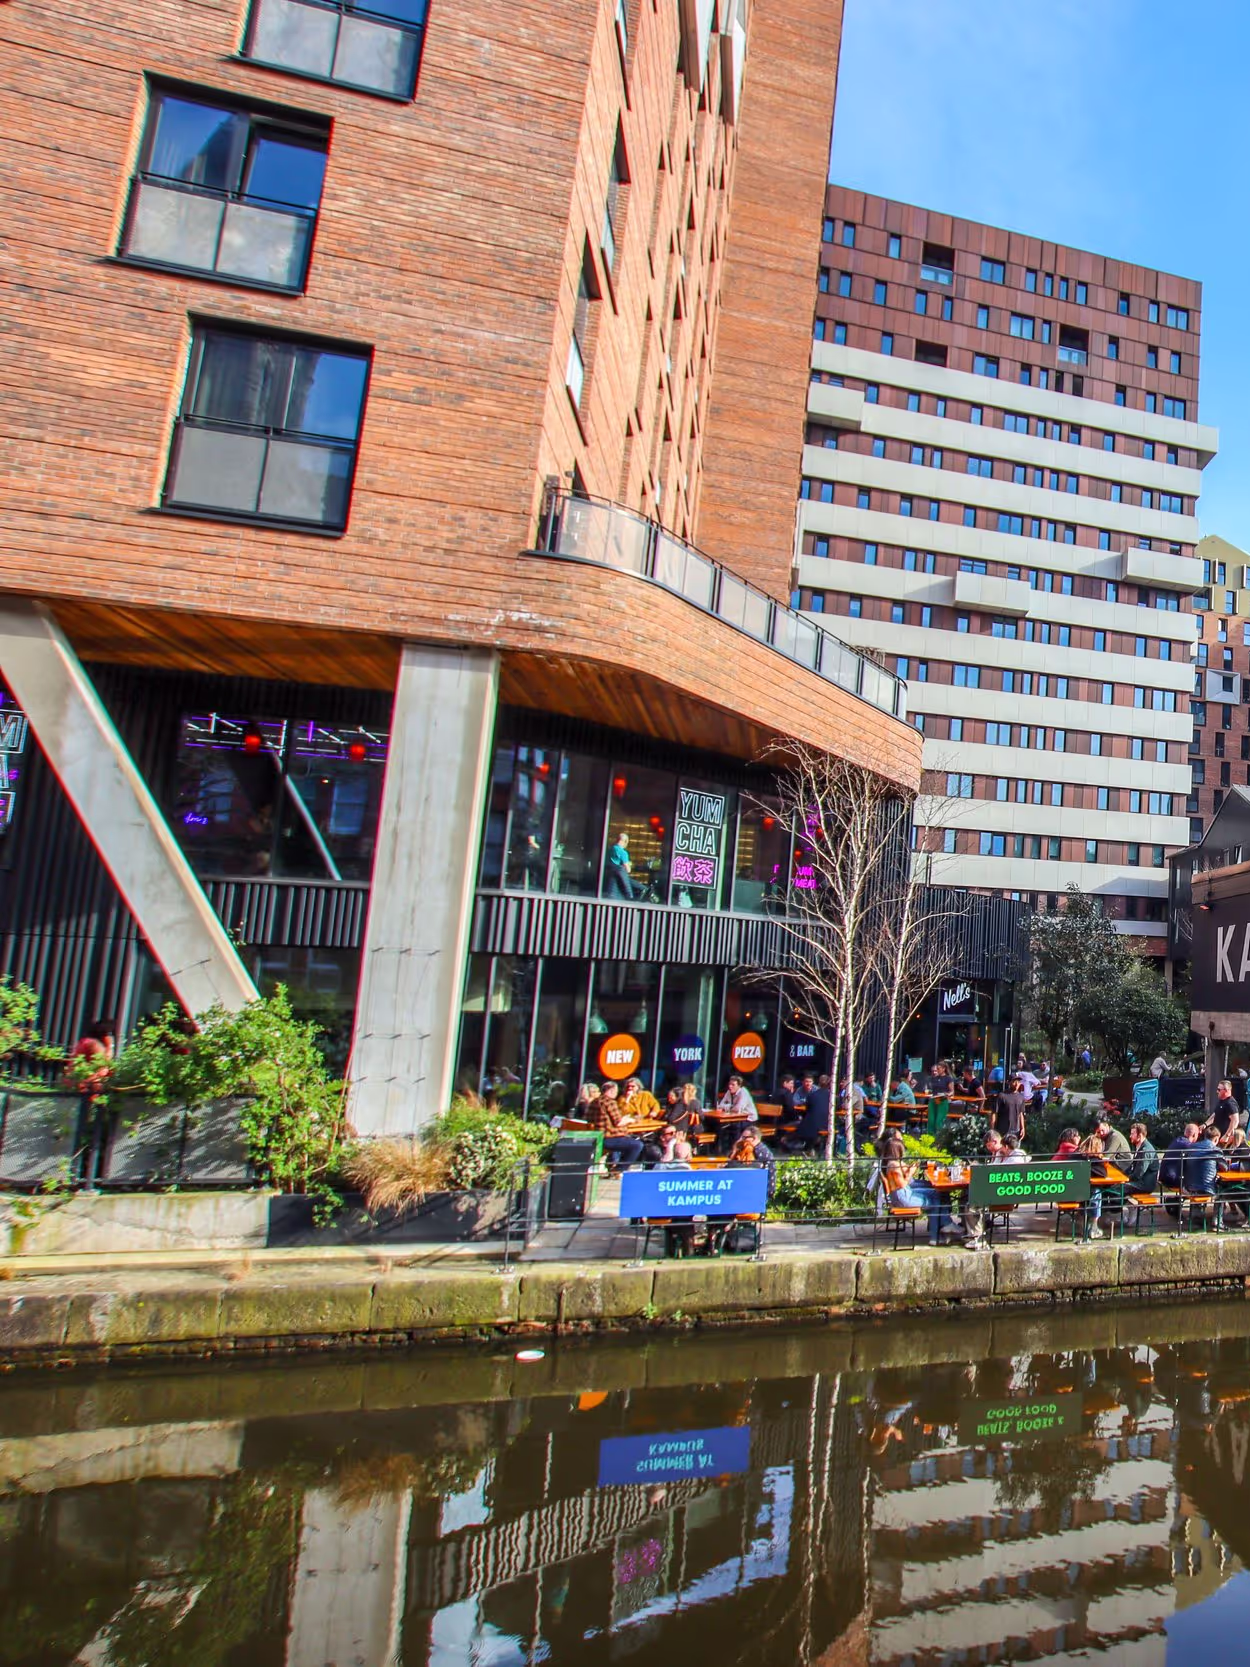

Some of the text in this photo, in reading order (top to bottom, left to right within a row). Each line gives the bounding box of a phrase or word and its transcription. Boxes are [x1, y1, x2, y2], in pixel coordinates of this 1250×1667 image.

[681, 791, 721, 824] YUM
[675, 823, 716, 855] CHA
[943, 982, 971, 1011] Nell's
[606, 1045, 814, 1064] NEW YORK PIZZA & BAR
[988, 1170, 1074, 1183] BEATS, BOOZE &
[658, 1179, 733, 1192] SUMMER AT
[996, 1184, 1066, 1196] GOOD FOOD
[667, 1194, 721, 1206] KAMPUS
